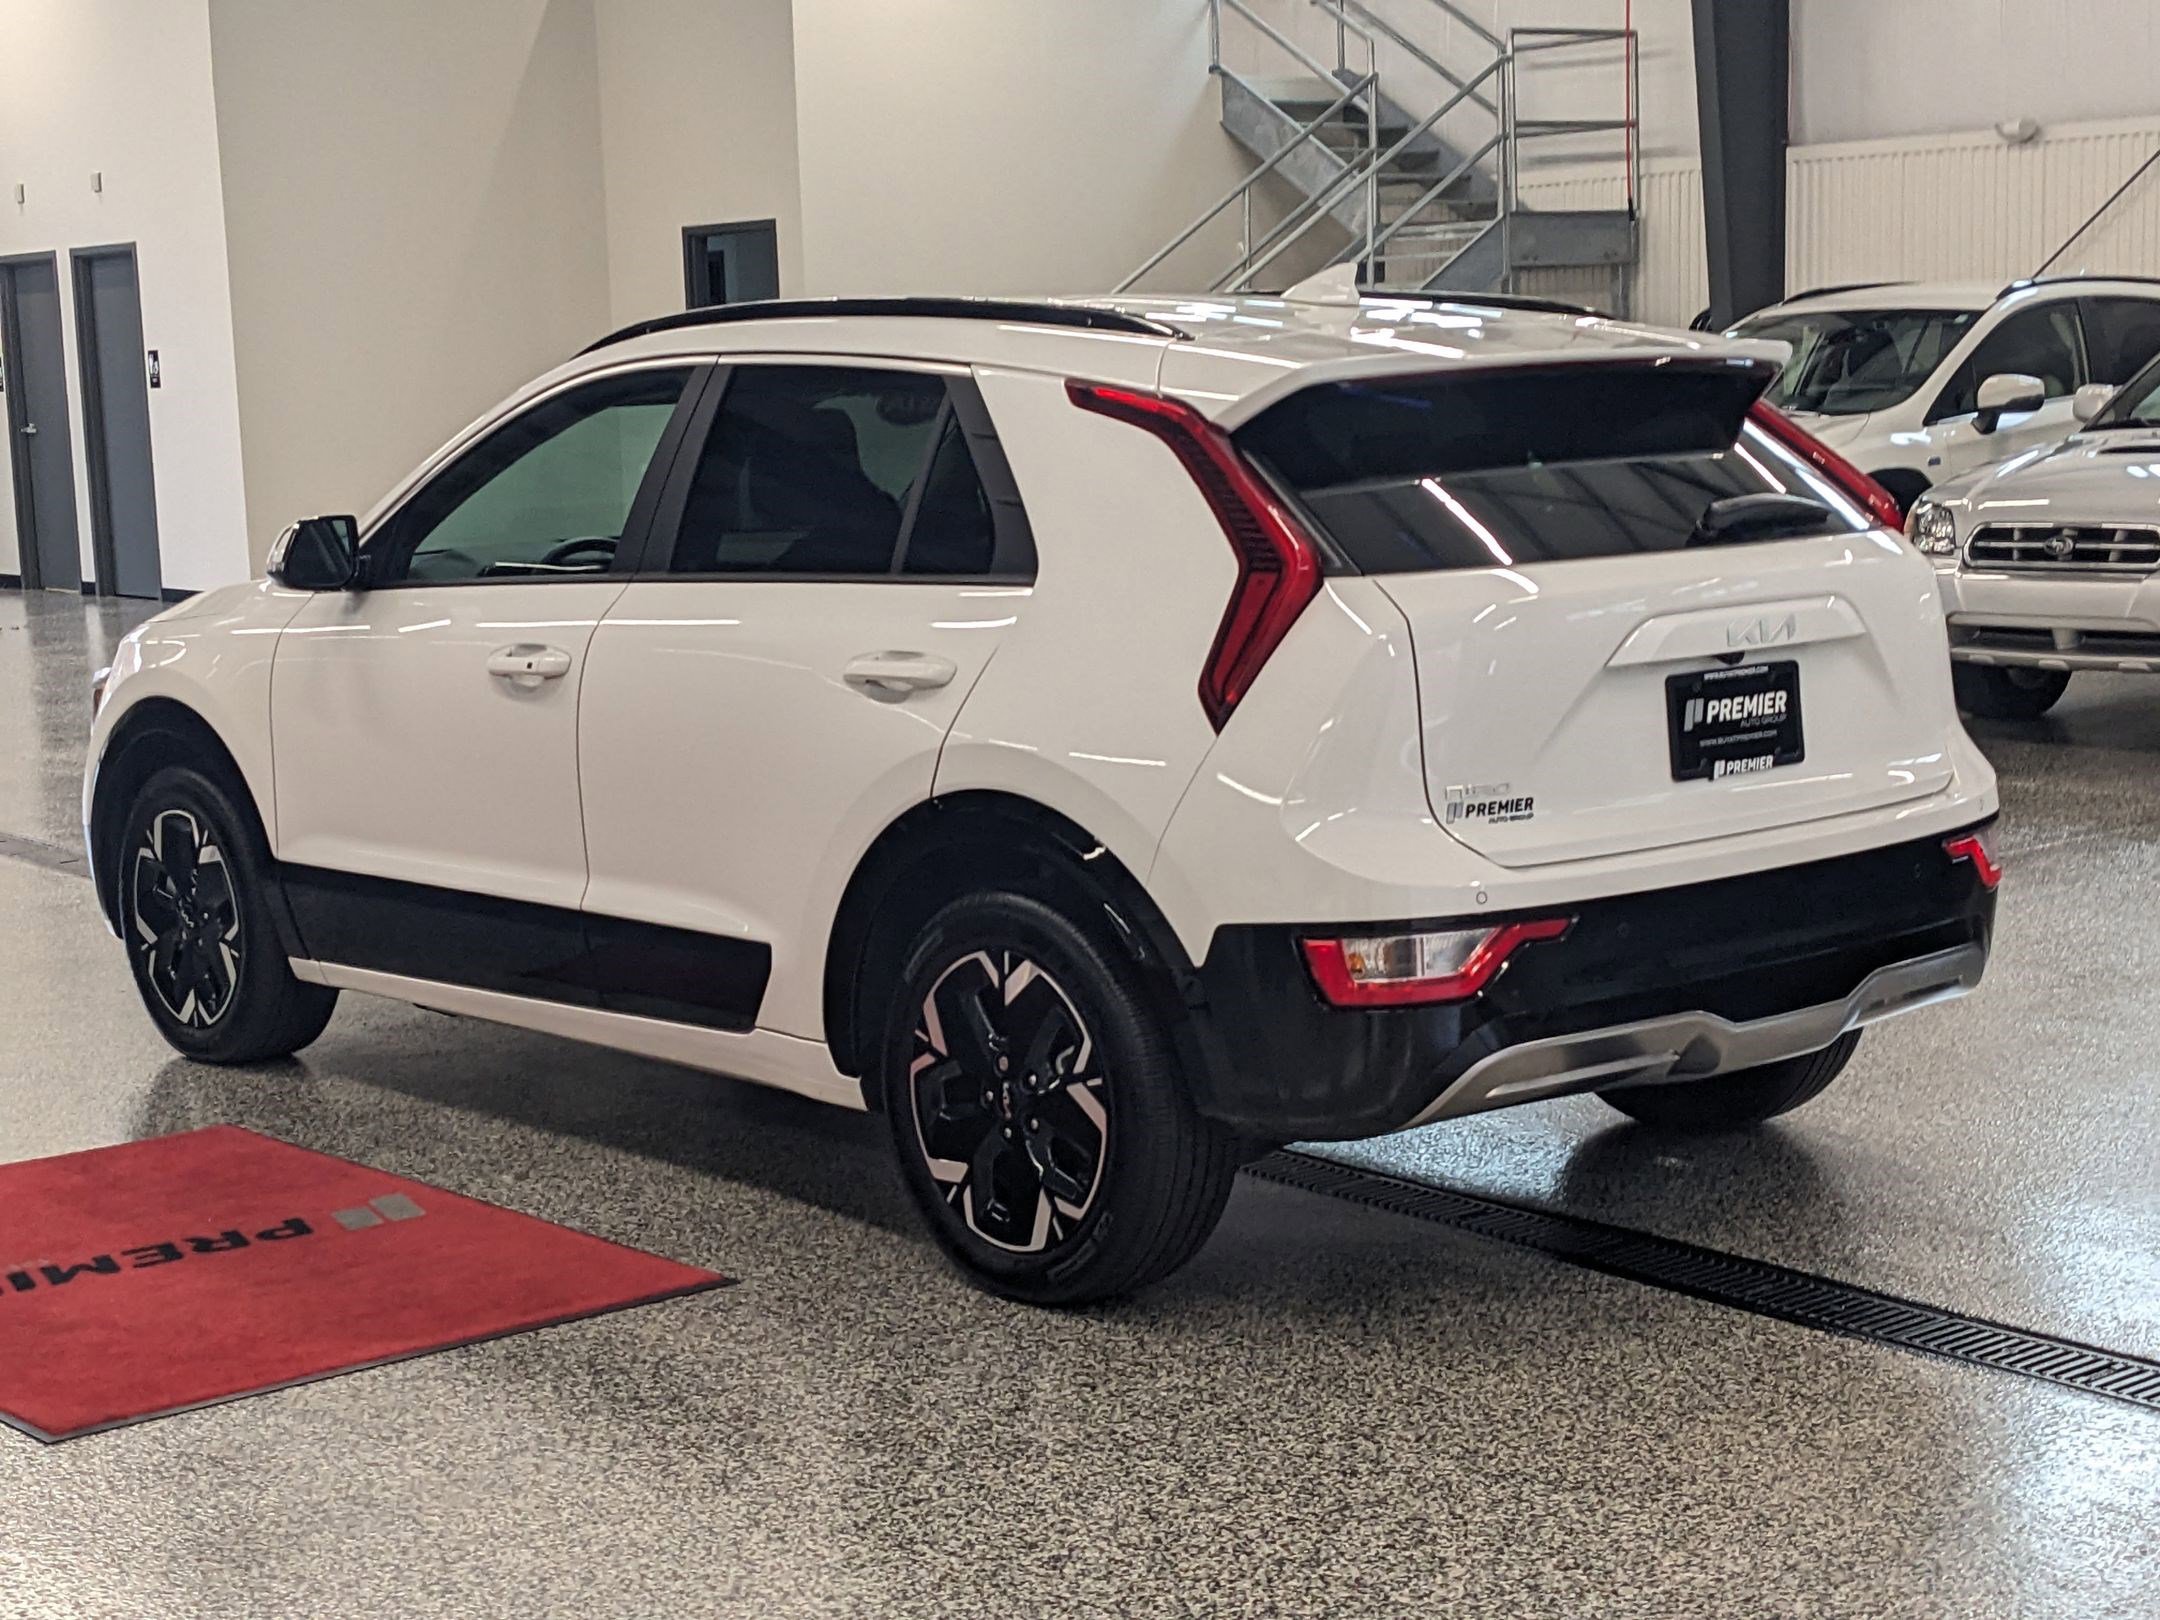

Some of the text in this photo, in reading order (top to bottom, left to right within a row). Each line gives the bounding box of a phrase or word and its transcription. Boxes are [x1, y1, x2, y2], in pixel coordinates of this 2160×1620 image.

[1727, 613, 1796, 647] KIA
[1706, 690, 1788, 724] PREMIER
[1740, 714, 1787, 728] AUTO GROUP
[1726, 755, 1774, 775] PREMIER
[1465, 797, 1534, 818] PREMIER
[0, 1217, 314, 1297] PREMI
